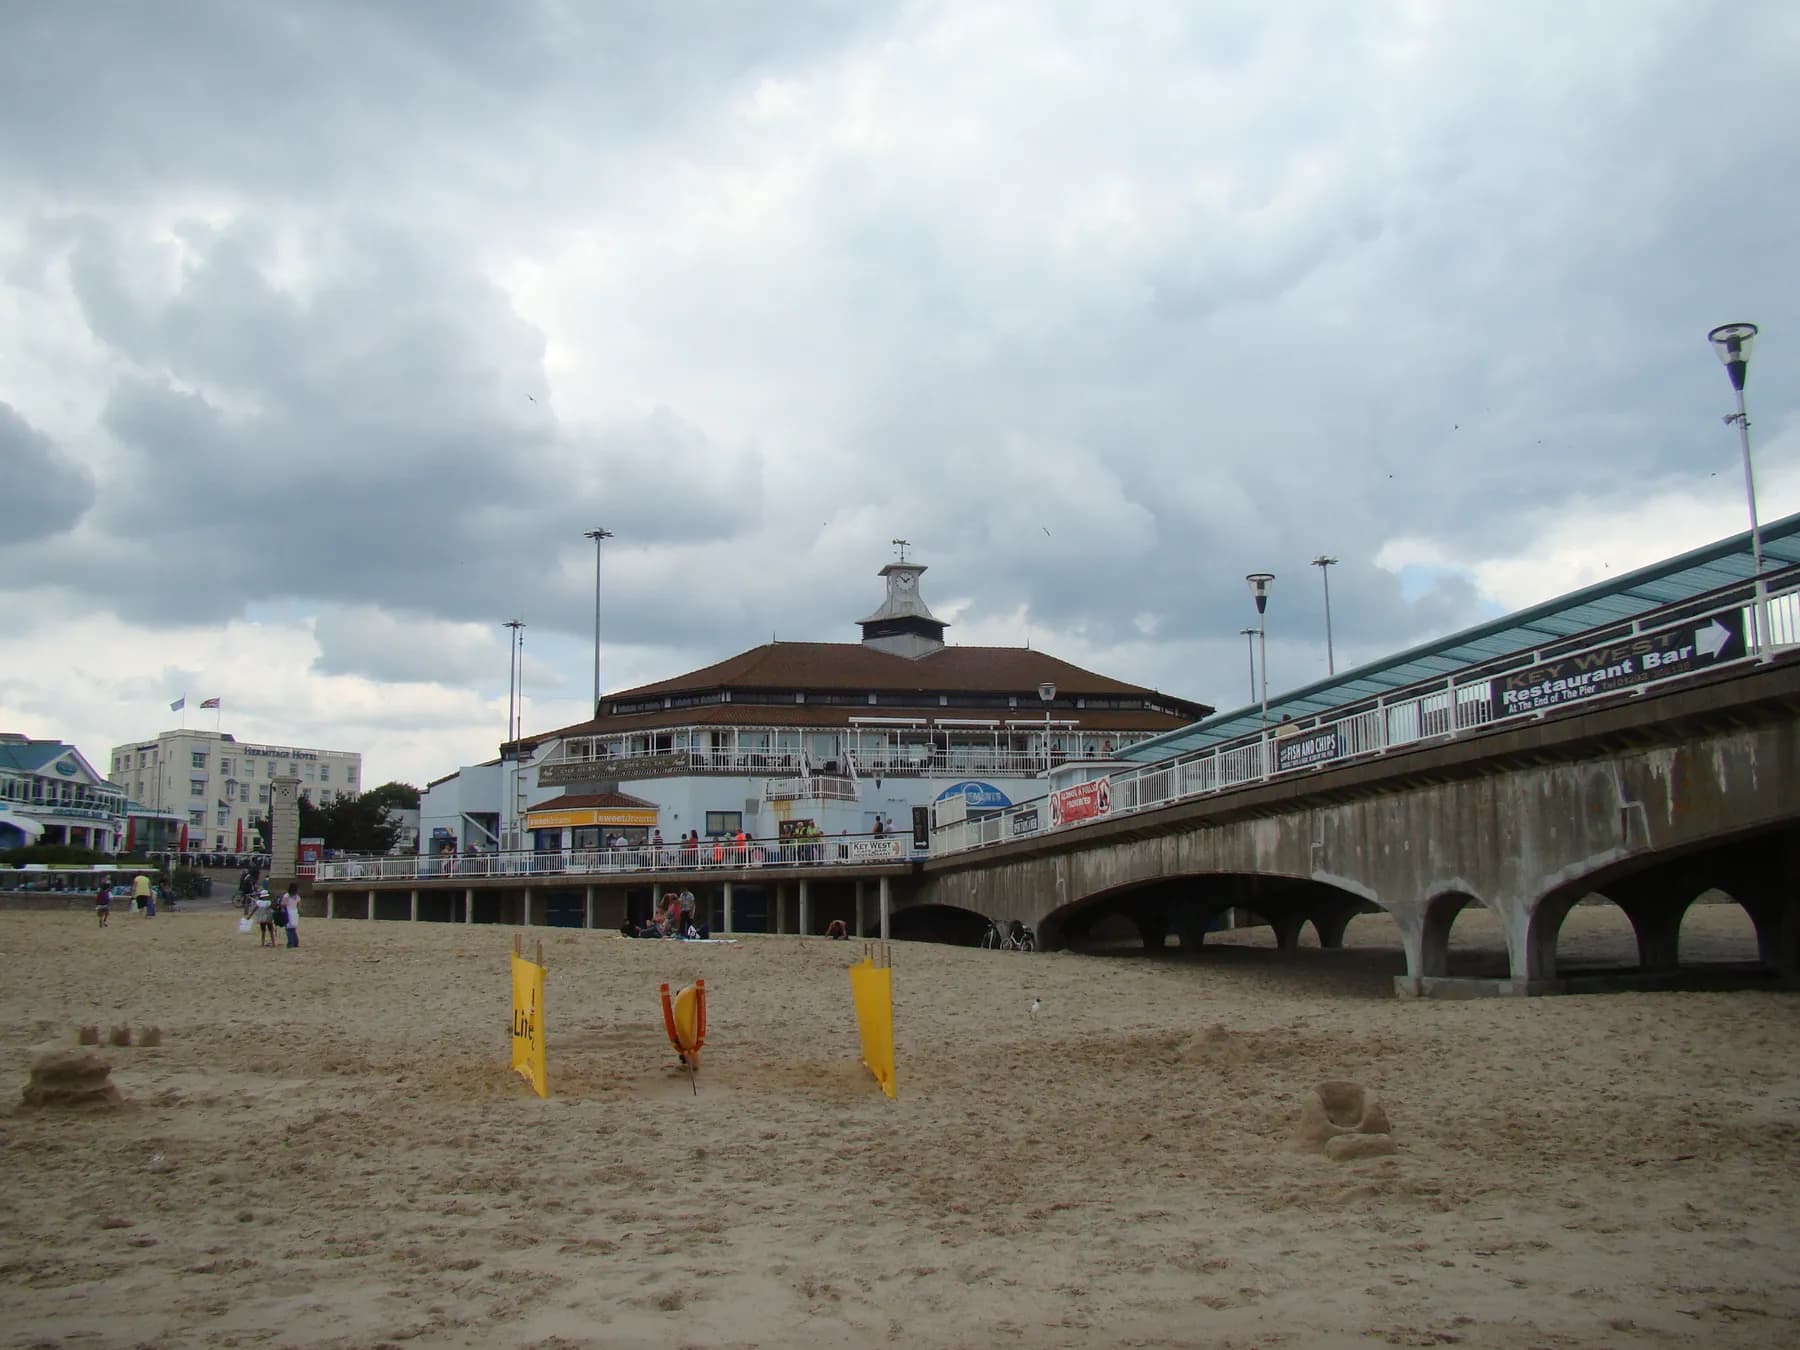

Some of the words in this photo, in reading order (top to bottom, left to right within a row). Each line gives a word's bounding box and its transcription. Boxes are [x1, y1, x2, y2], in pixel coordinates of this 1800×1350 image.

[1503, 658, 1633, 705] Restaurant
[1642, 645, 1692, 670] Bar
[1506, 663, 1565, 690] KEY
[1574, 631, 1678, 671] WEST
[1508, 703, 1519, 714] At
[1519, 699, 1533, 711] The
[1534, 694, 1549, 706] End
[1550, 691, 1560, 703] of
[1562, 688, 1579, 700] The
[1580, 684, 1597, 696] Pier
[244, 745, 290, 759] HERMITAGE
[292, 750, 319, 760] HOTEL
[1287, 743, 1301, 761] FISH
[1301, 739, 1315, 757] AND
[1315, 733, 1336, 753] CHIPS
[853, 841, 869, 851] KEY
[870, 840, 891, 850] WEST
